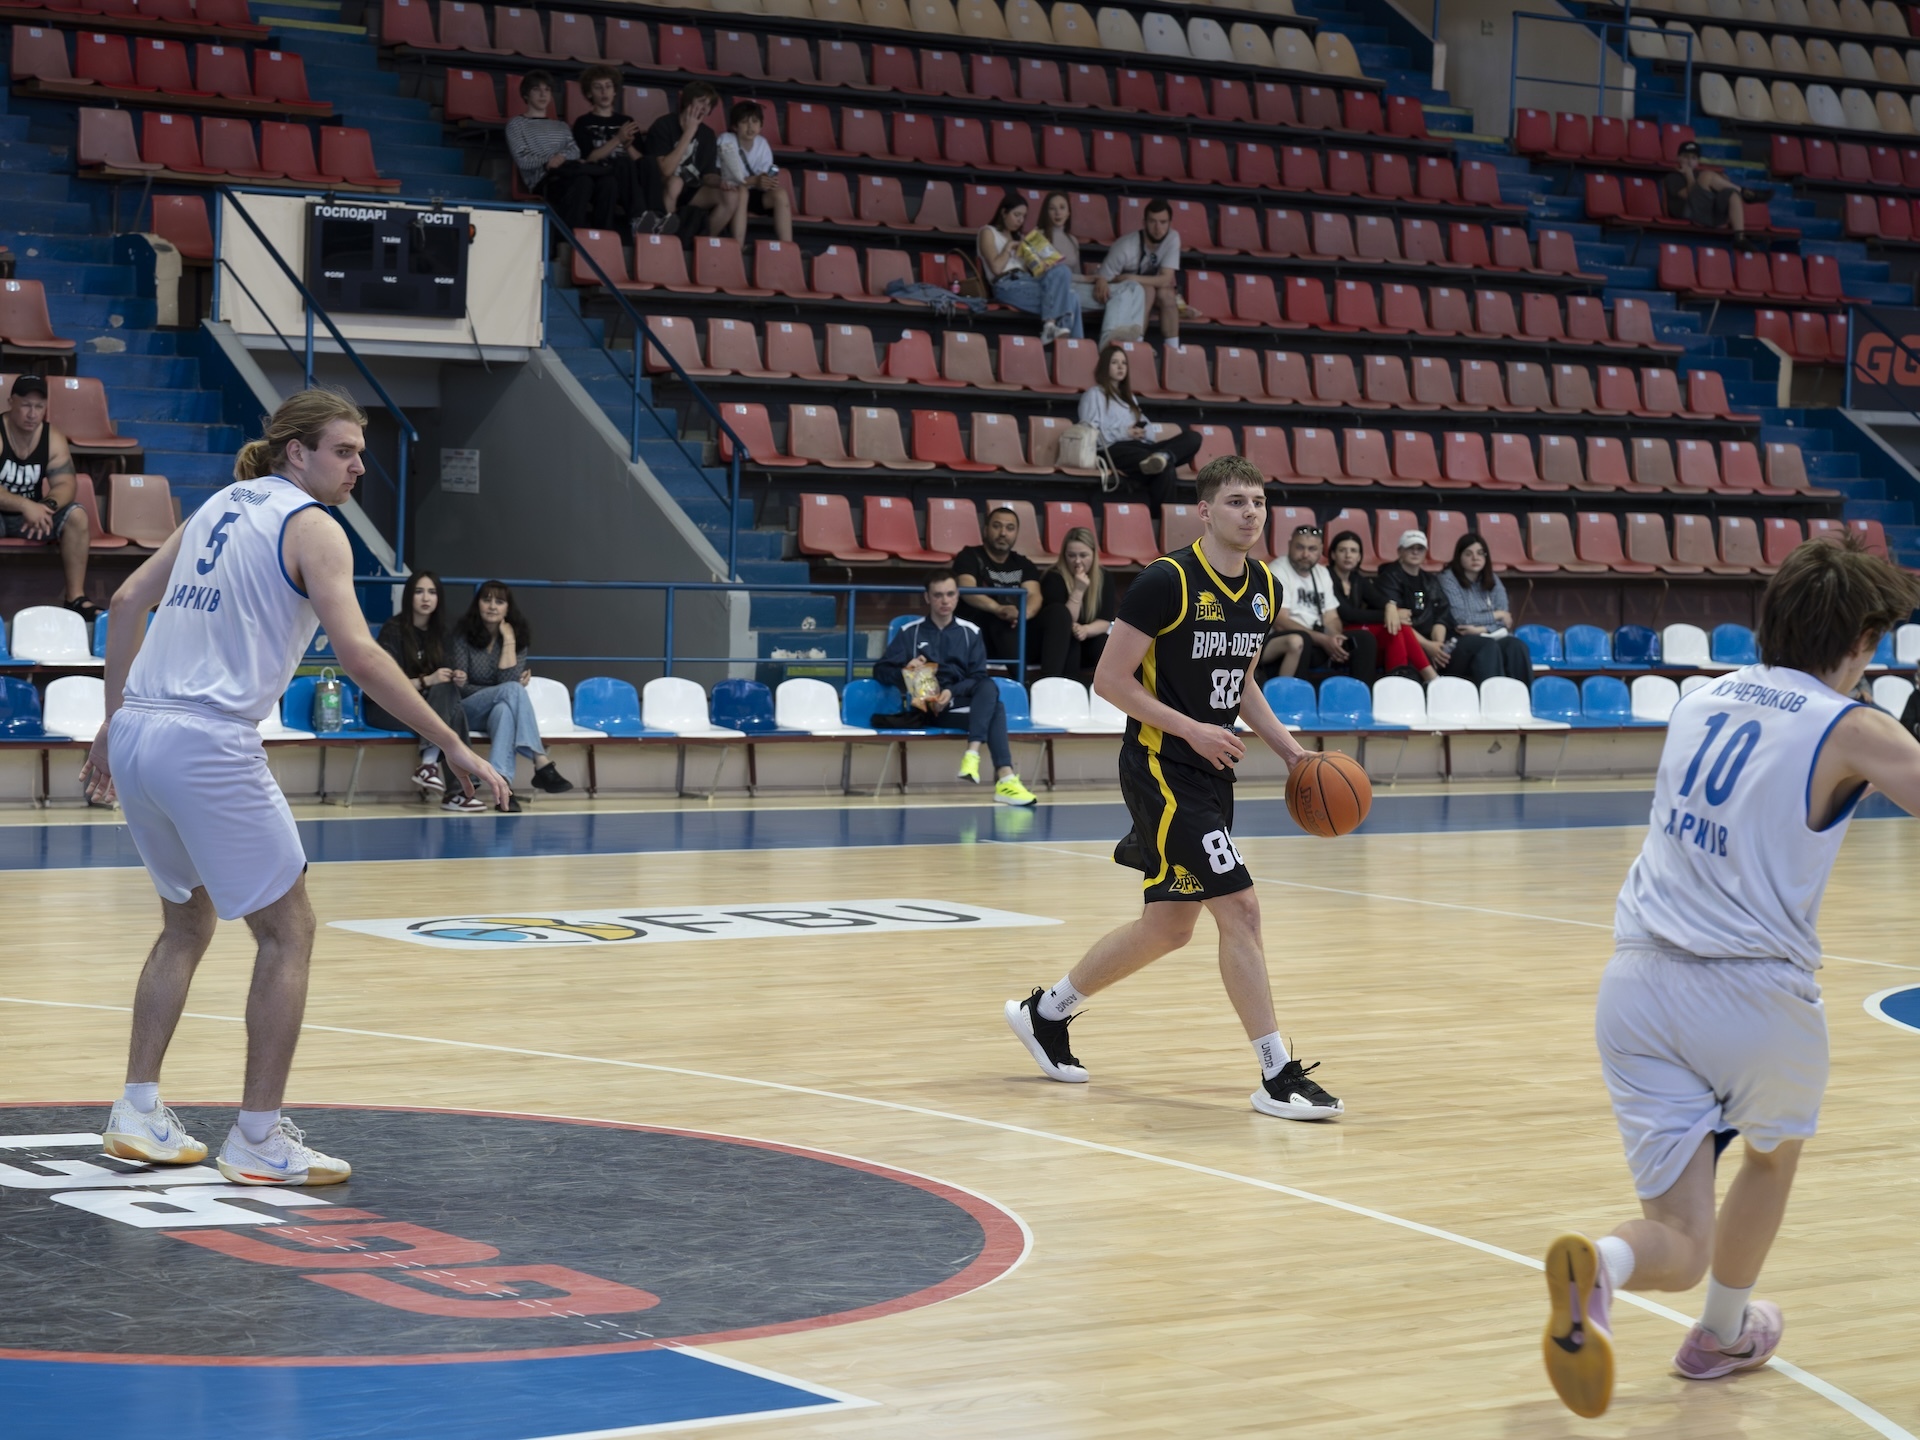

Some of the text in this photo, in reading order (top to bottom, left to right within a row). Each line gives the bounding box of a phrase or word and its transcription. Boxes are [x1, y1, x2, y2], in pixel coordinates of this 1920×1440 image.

[383, 276, 397, 284] ЧАС
[229, 487, 272, 506] ЧОРНИЙ
[196, 511, 241, 576] 5
[1209, 668, 1244, 710] 88
[1711, 680, 1808, 713] КУЧЕРЮКОВ
[1678, 711, 1762, 807] 10
[619, 904, 983, 934] FBU
[1055, 993, 1078, 1013] ARMR
[1261, 1041, 1274, 1069] UNDR
